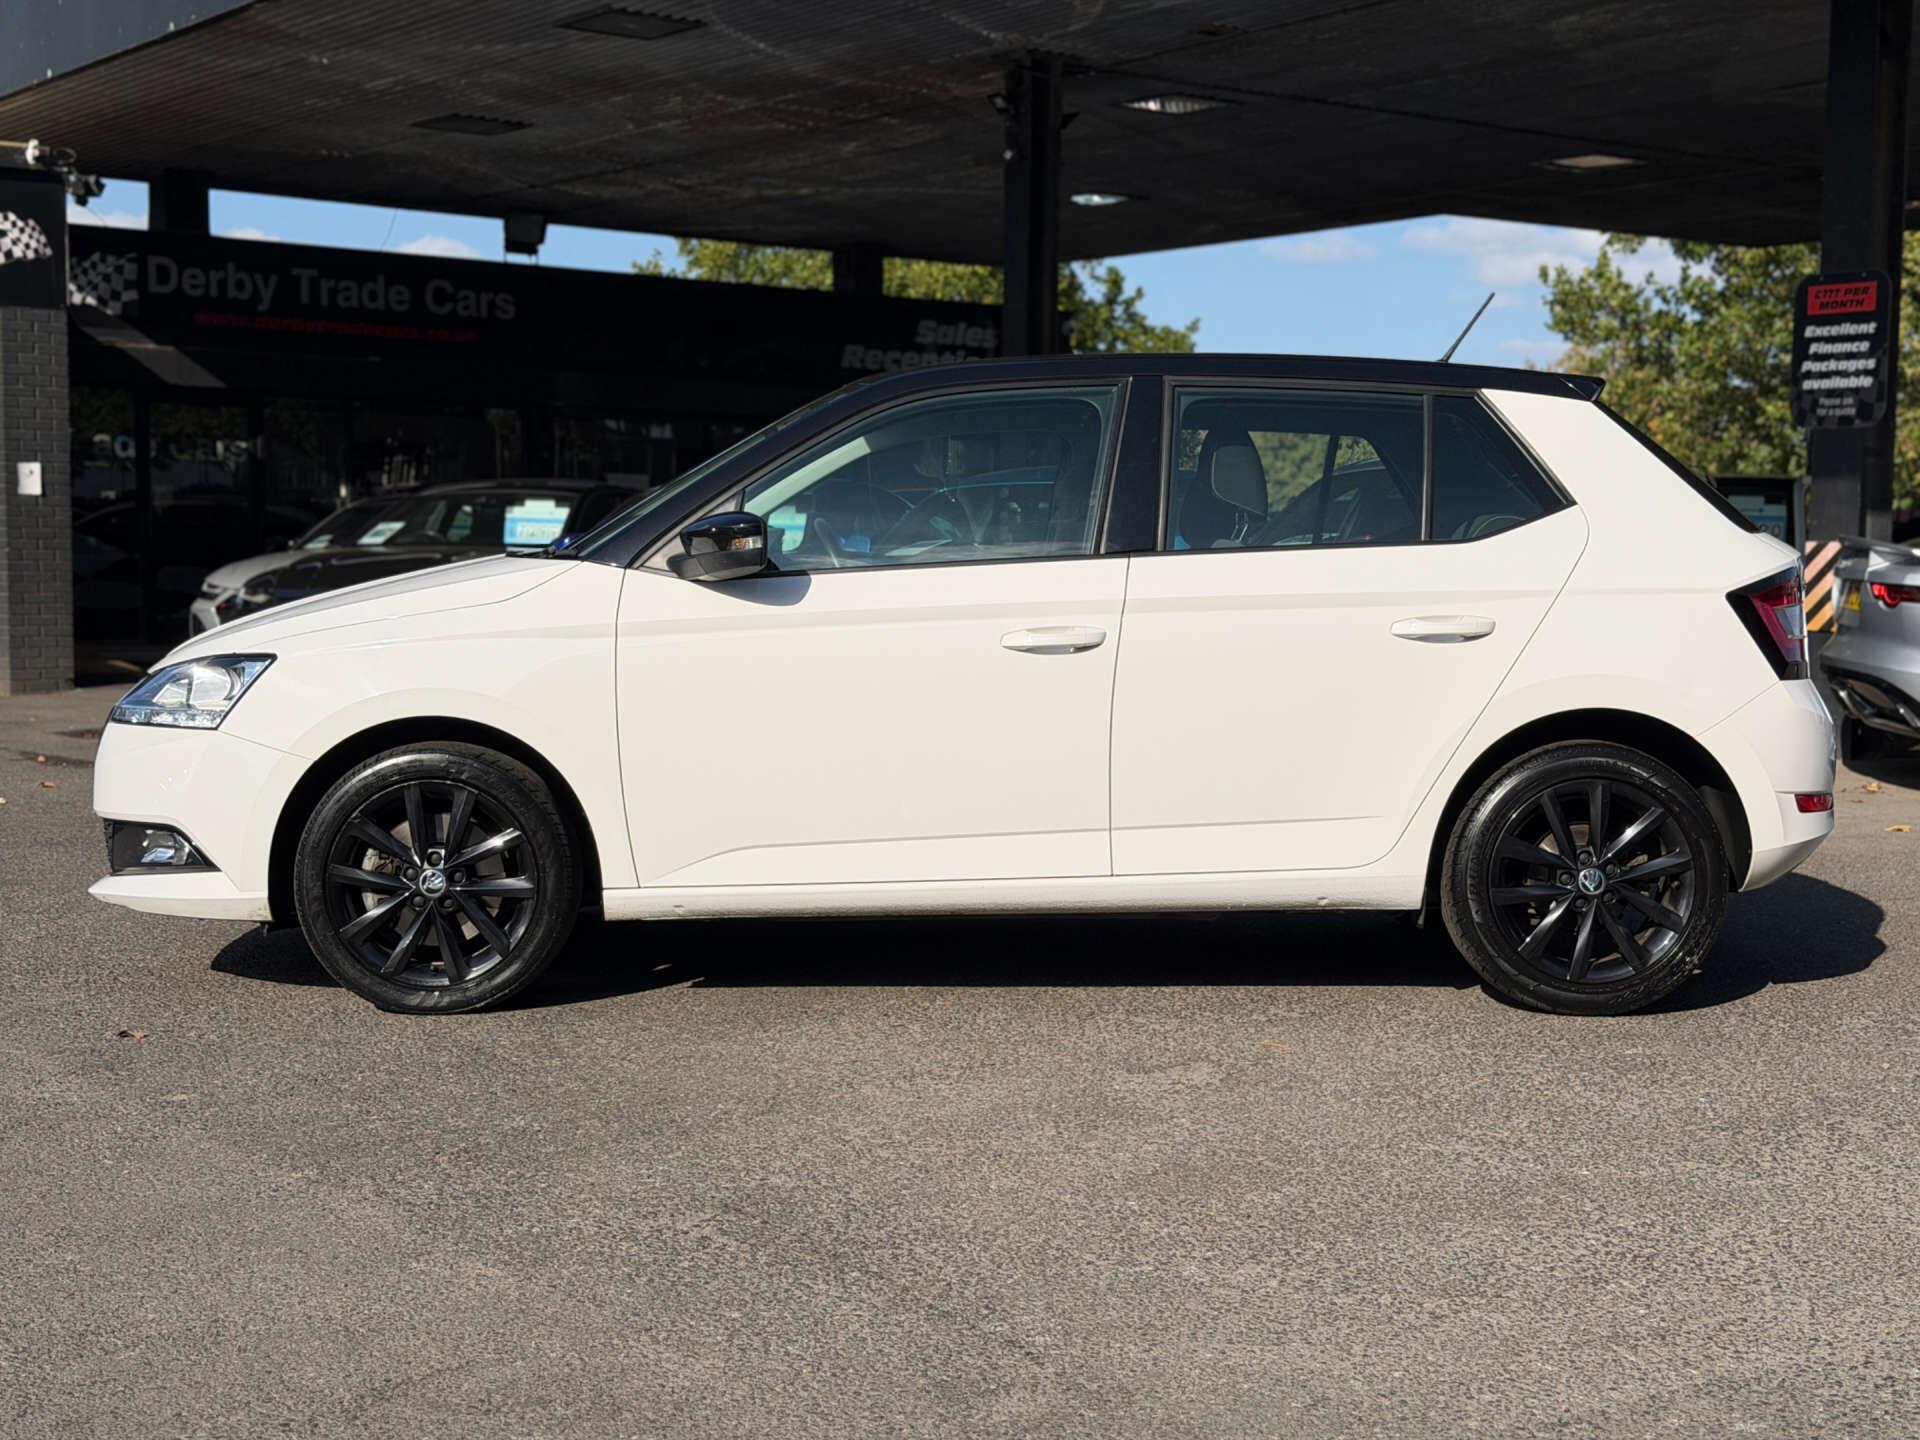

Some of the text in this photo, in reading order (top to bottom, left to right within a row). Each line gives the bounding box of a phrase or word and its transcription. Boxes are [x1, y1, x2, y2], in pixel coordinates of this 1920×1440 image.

[147, 255, 516, 321] Derby Trade Cars
[1819, 299, 1864, 311] MONTH
[915, 319, 998, 348] Sales
[1804, 321, 1877, 338] Excellent
[1808, 340, 1870, 355] Finance
[1801, 358, 1876, 373] Packages
[1802, 376, 1873, 391] available
